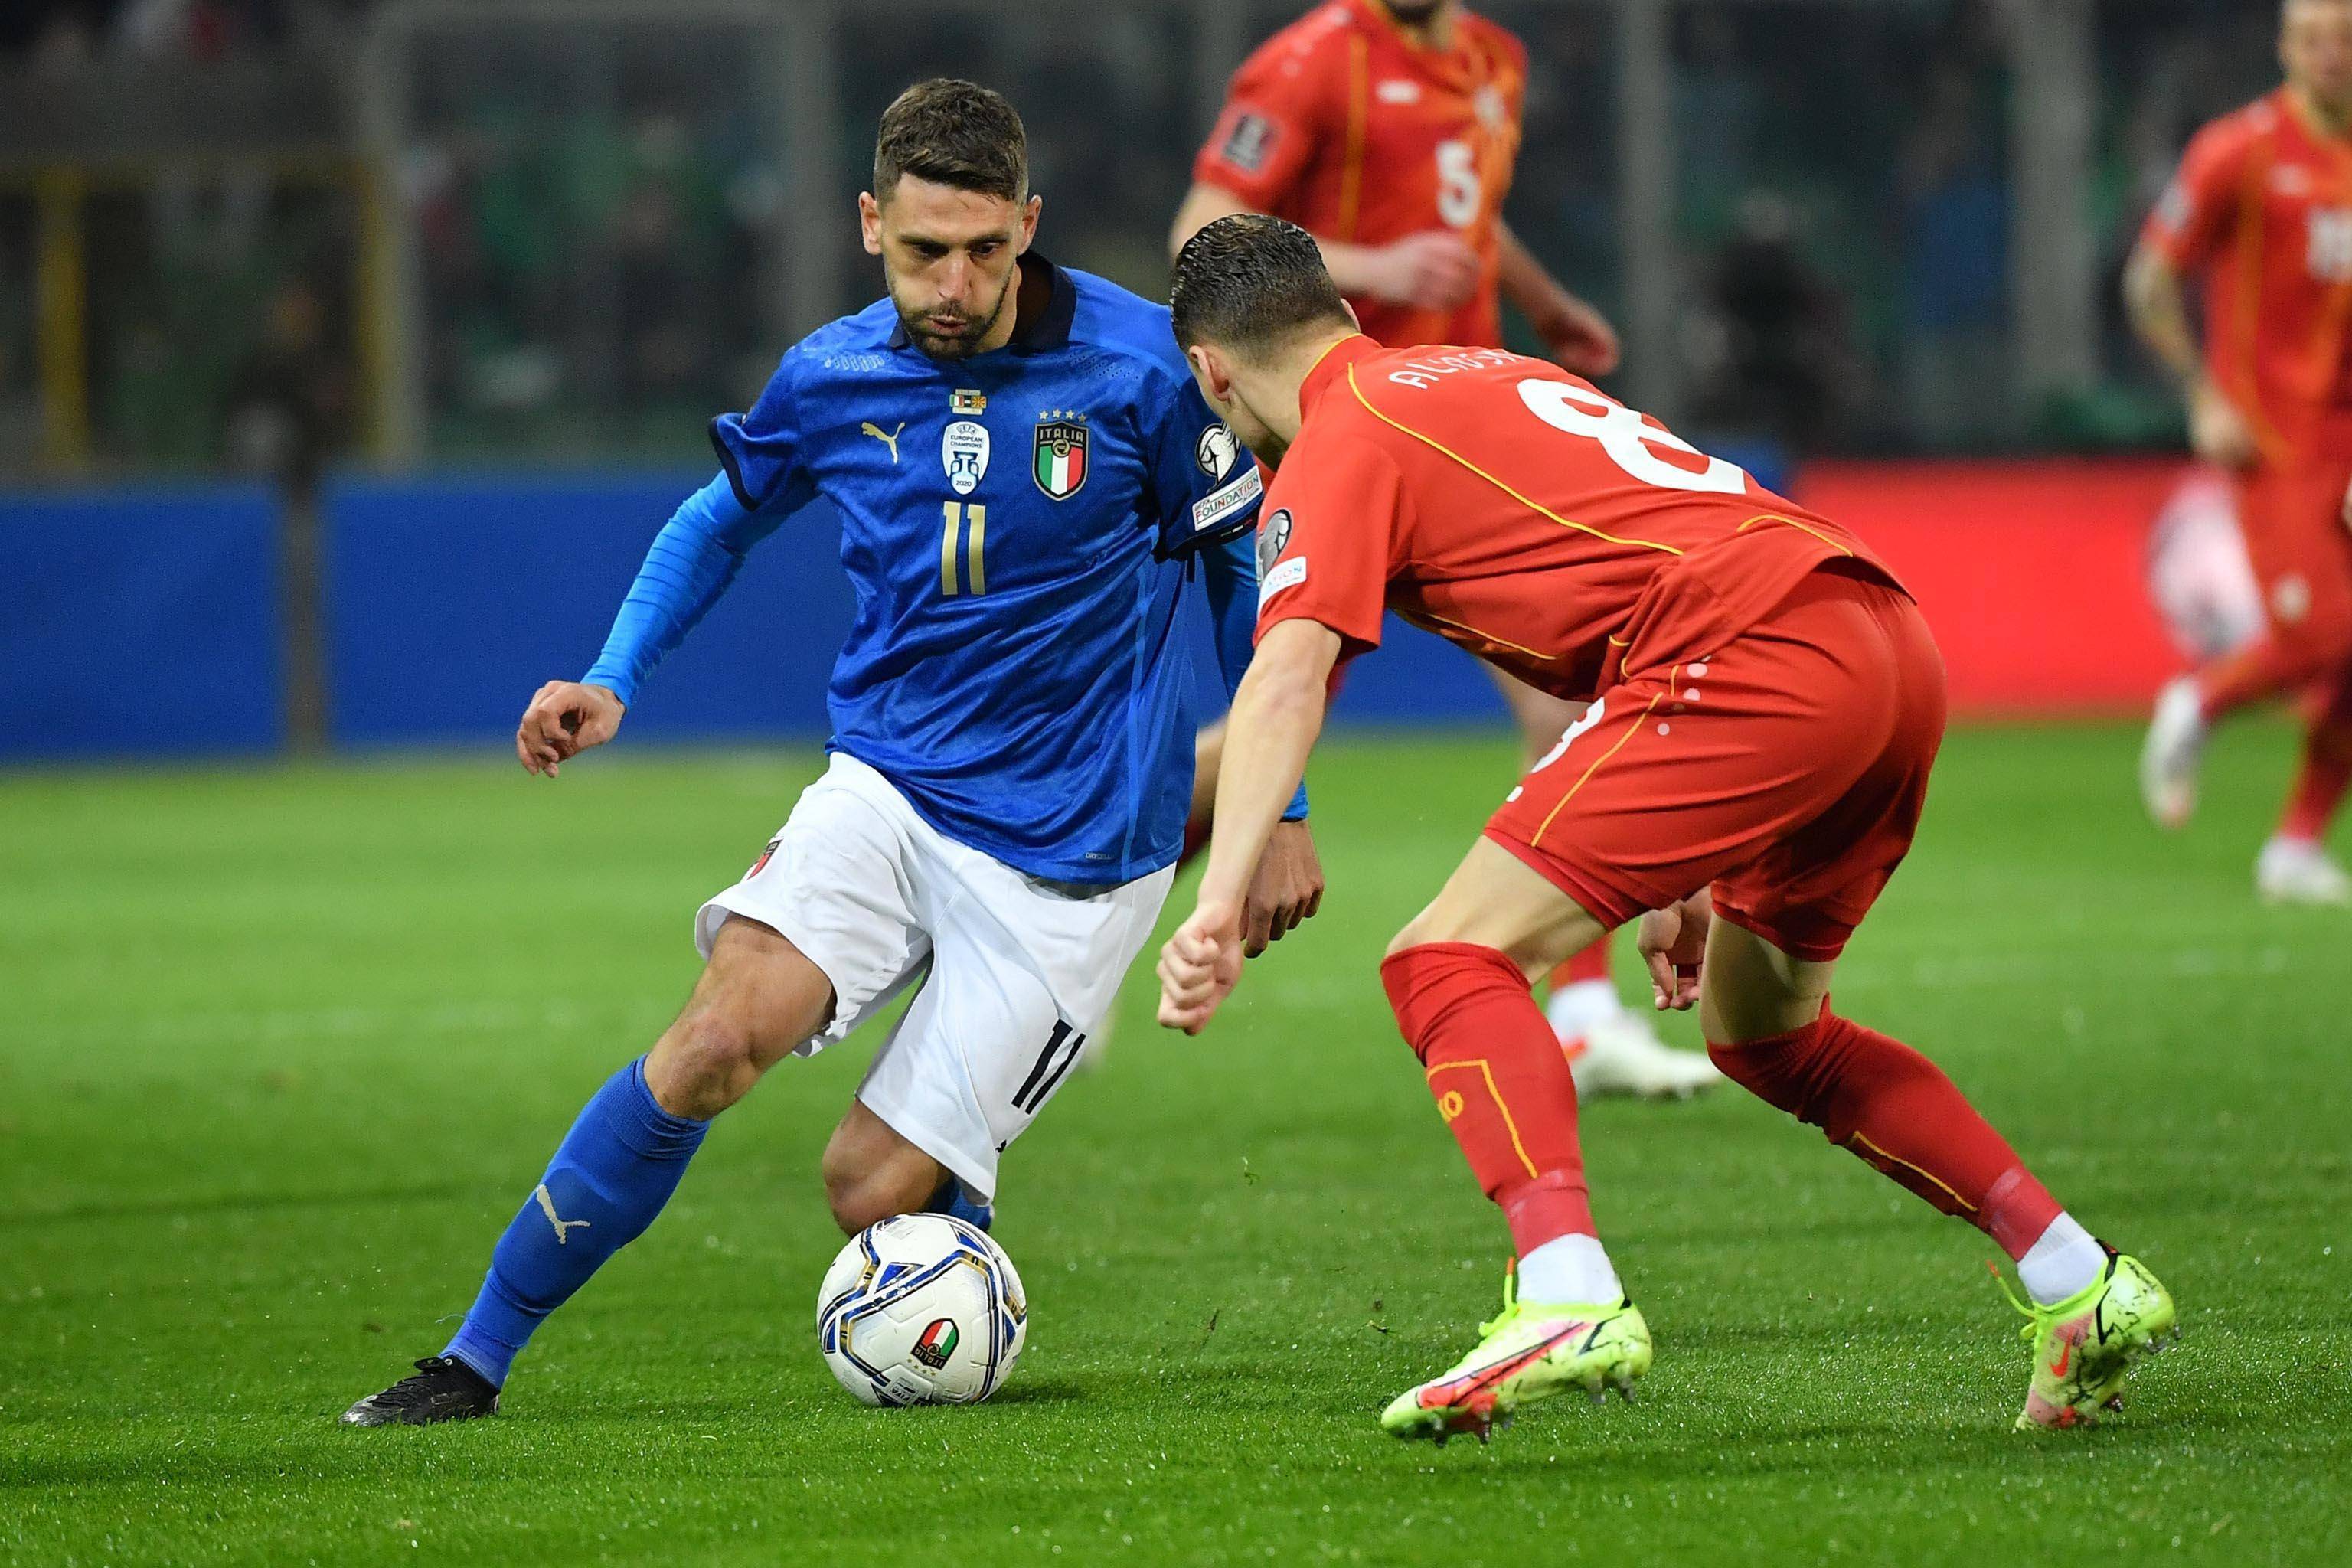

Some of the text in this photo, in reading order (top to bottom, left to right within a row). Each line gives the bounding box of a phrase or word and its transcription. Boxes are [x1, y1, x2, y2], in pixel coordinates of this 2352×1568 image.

[1435, 140, 1481, 227] 5
[950, 440, 983, 449] CHAMPIONS
[1040, 428, 1084, 443] ITALIA
[1517, 378, 1746, 495] 8
[1195, 475, 1259, 521] FOUNDATION
[941, 501, 986, 596] 11
[1011, 1018, 1086, 1115] 11
[914, 1348, 944, 1367] ITALIA
